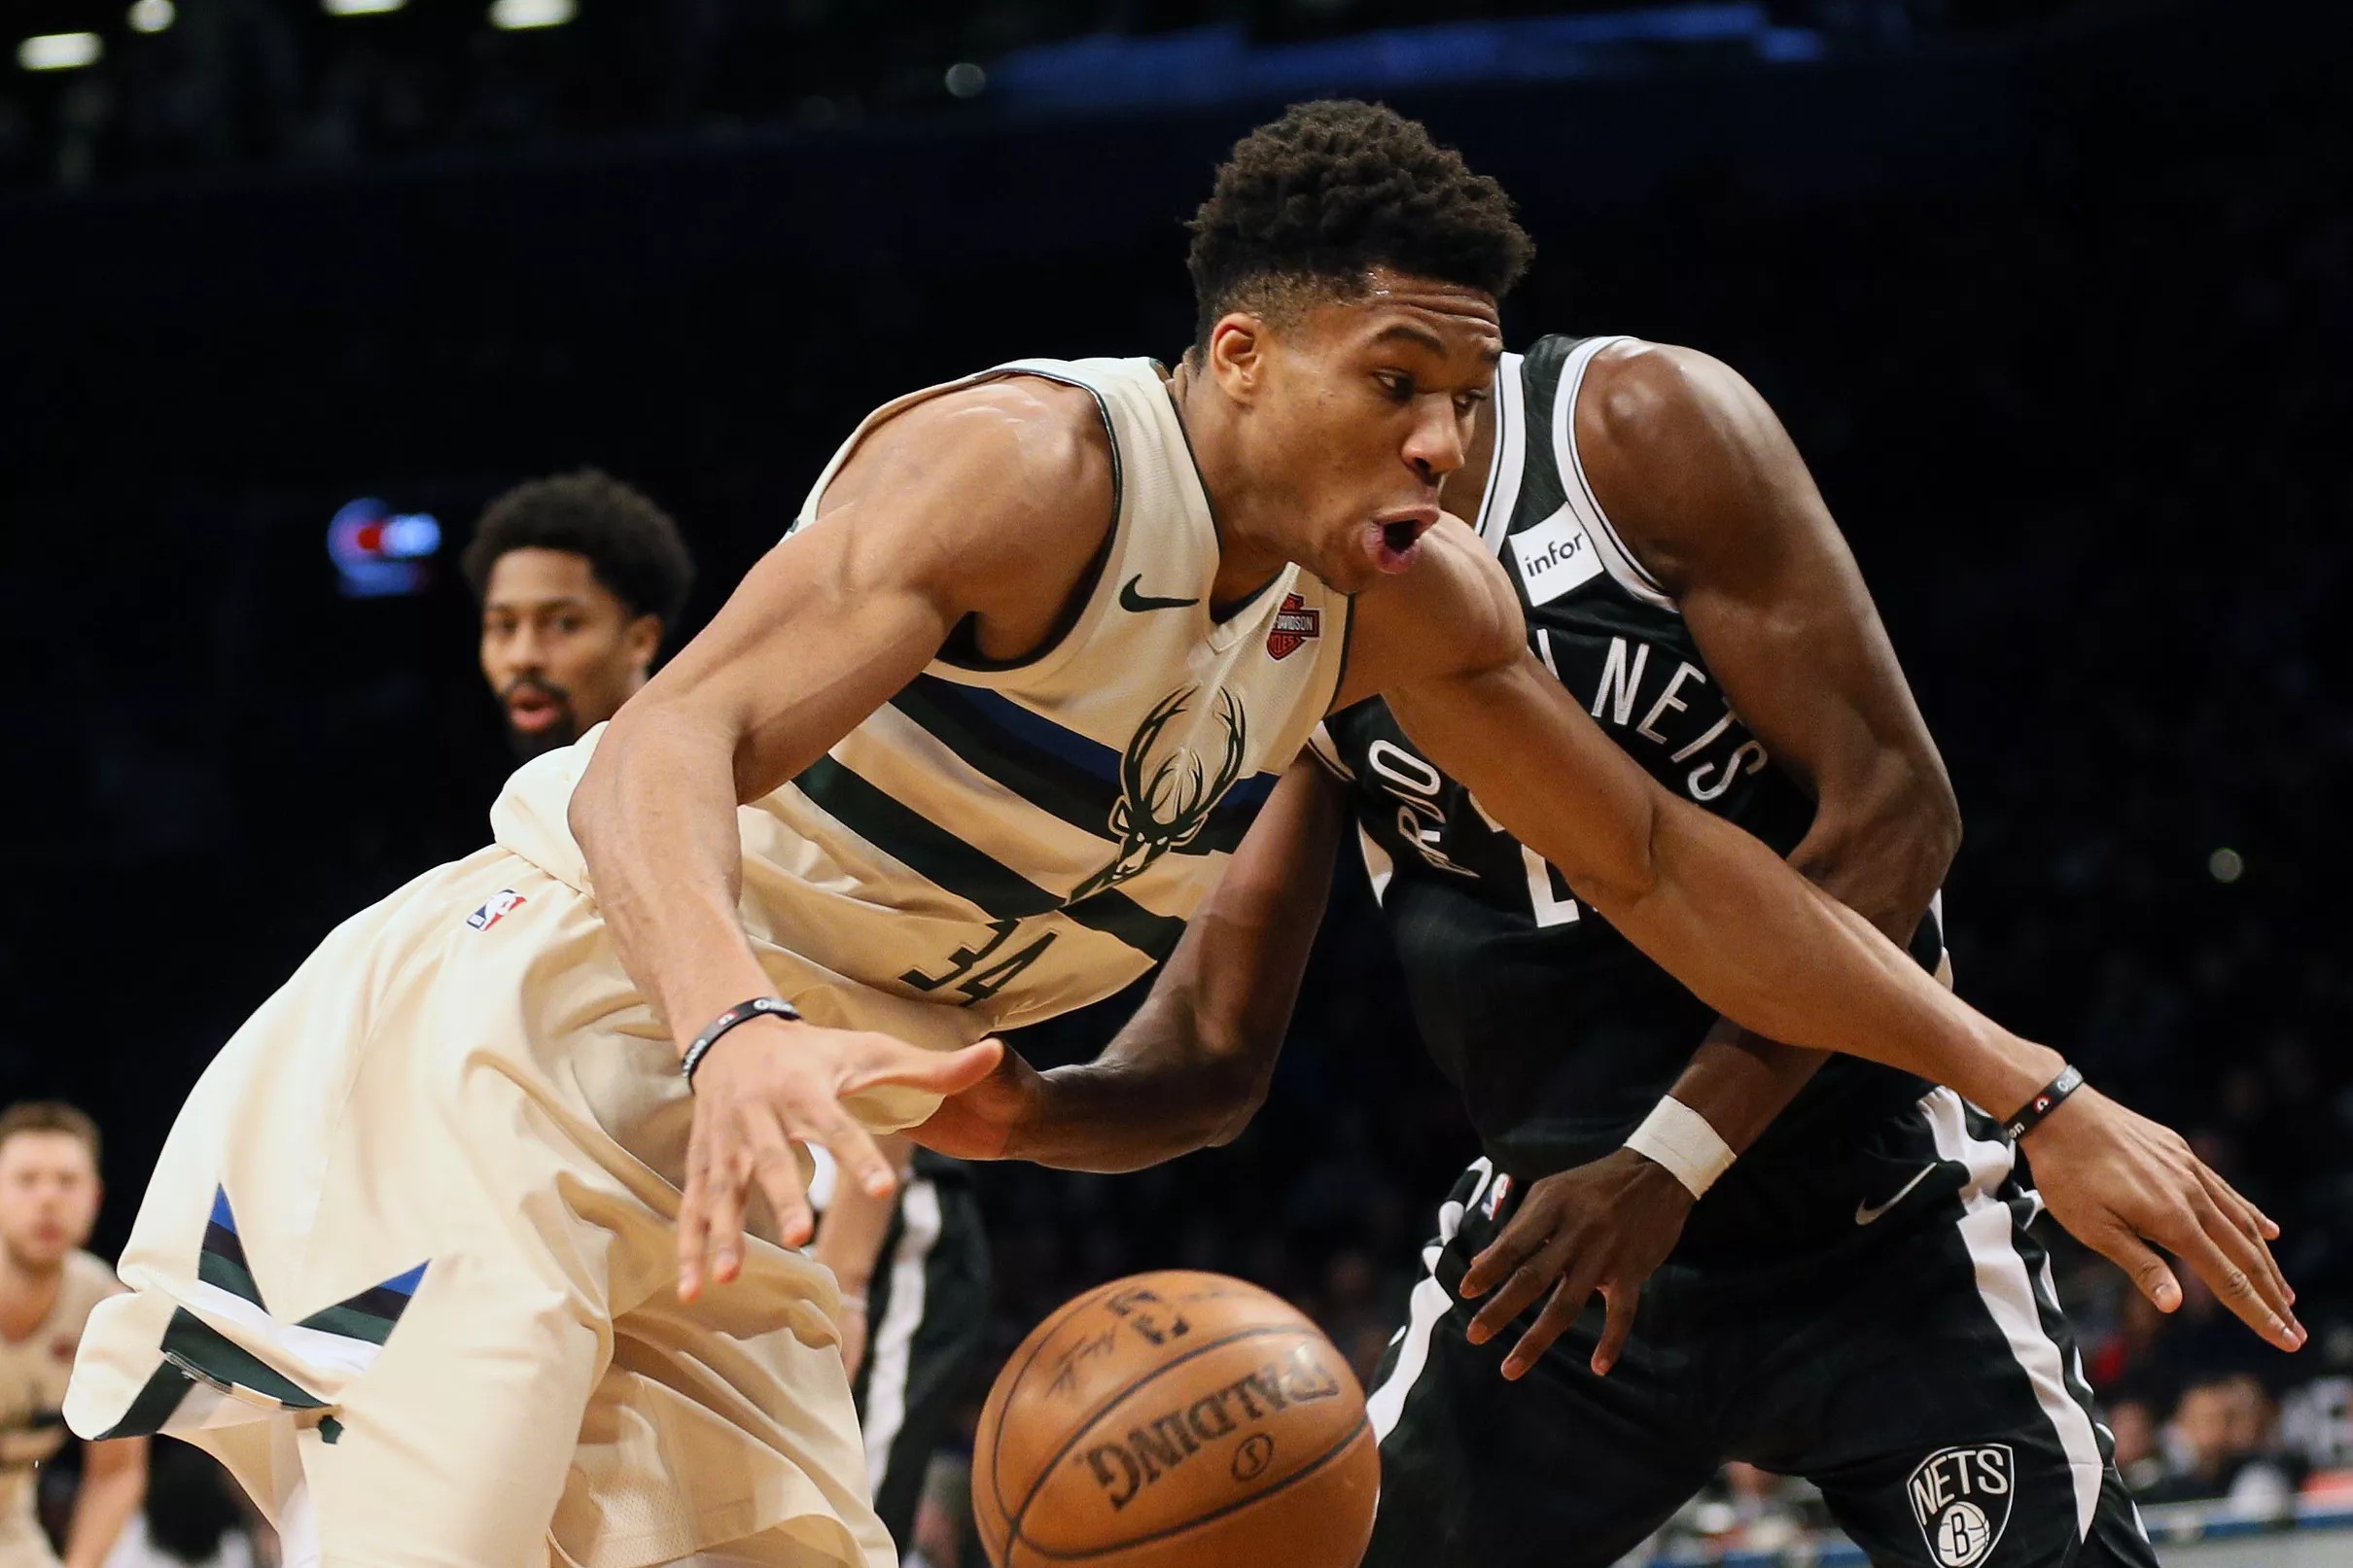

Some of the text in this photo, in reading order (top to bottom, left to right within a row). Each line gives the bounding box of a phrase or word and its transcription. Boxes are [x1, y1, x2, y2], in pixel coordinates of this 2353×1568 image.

[1524, 532, 1583, 577] infor
[1590, 636, 1769, 802] NETS
[897, 918, 1059, 1008] 34
[1913, 1448, 2009, 1527] NETS
[1950, 1512, 1972, 1559] B
